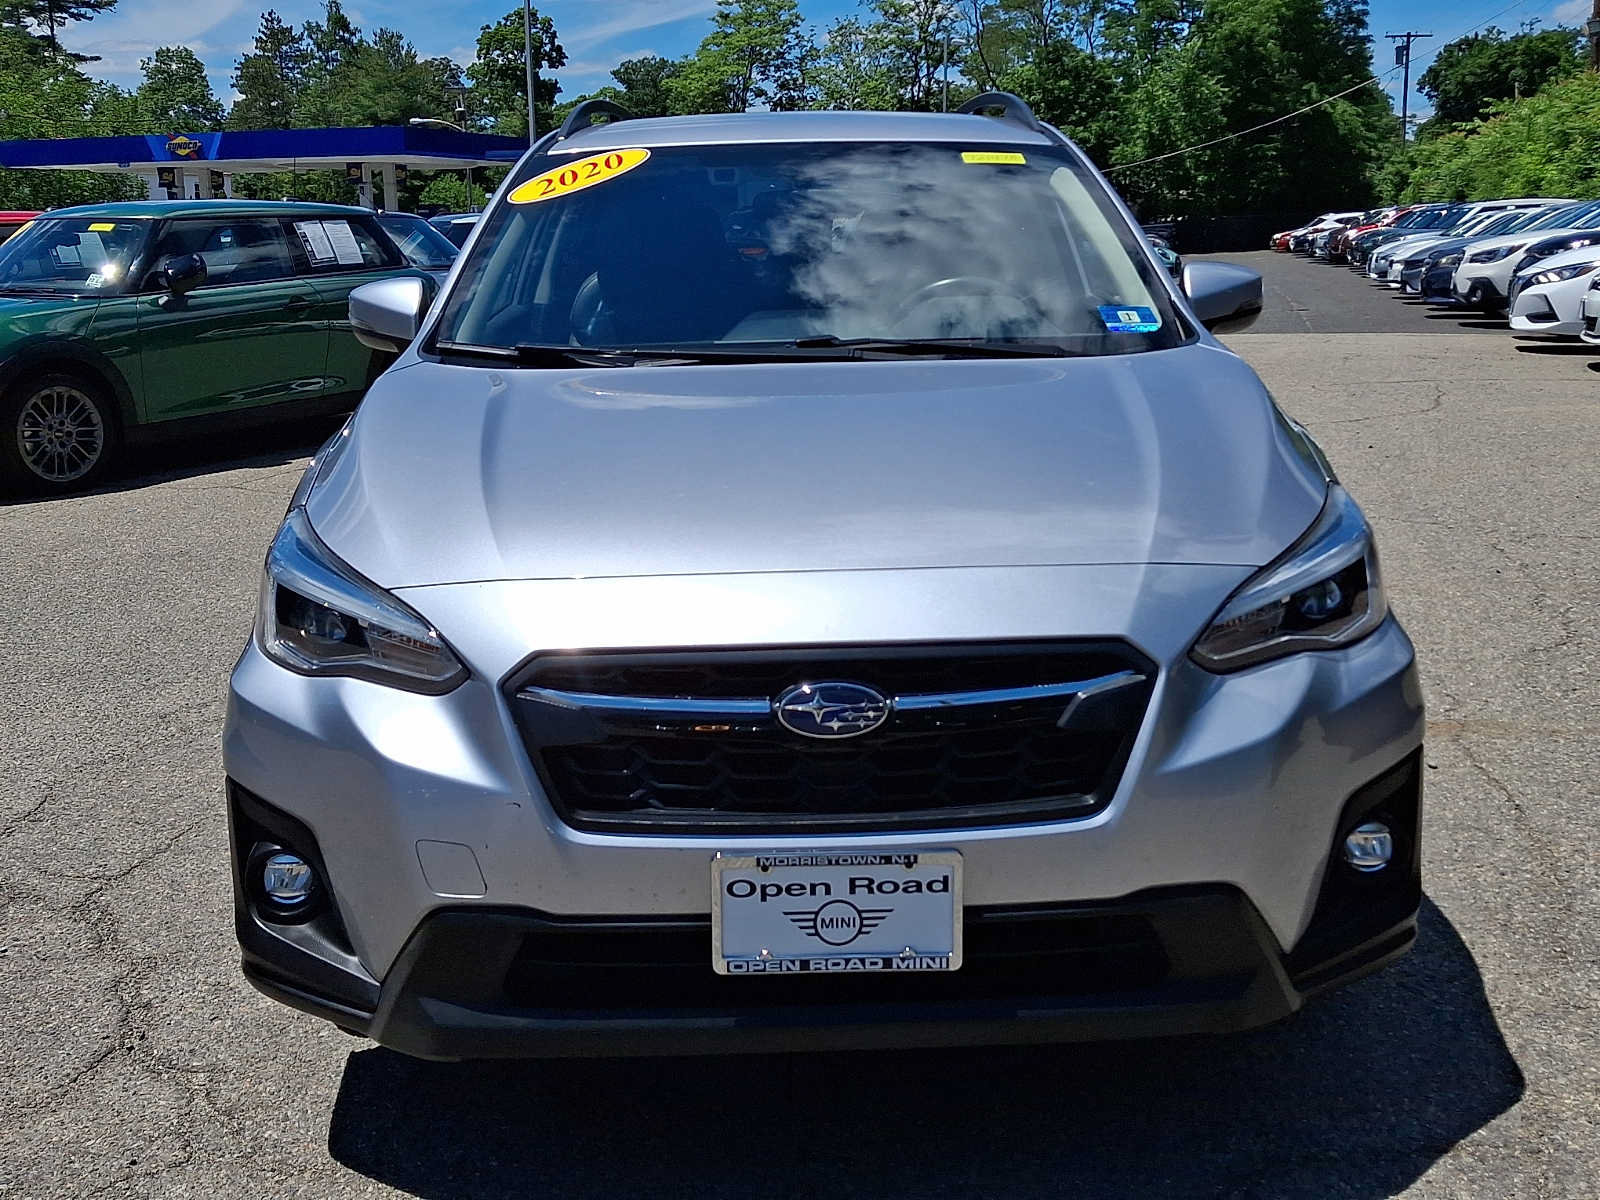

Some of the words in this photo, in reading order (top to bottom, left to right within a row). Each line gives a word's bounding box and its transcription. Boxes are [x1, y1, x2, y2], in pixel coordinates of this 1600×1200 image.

[167, 141, 198, 151] SUNOCO
[536, 154, 623, 195] 2020
[726, 878, 832, 902] Open
[849, 875, 949, 895] Road
[820, 917, 857, 929] MINI
[729, 959, 800, 972] OPEN
[809, 958, 883, 971] ROAD
[892, 956, 949, 969] MINI
